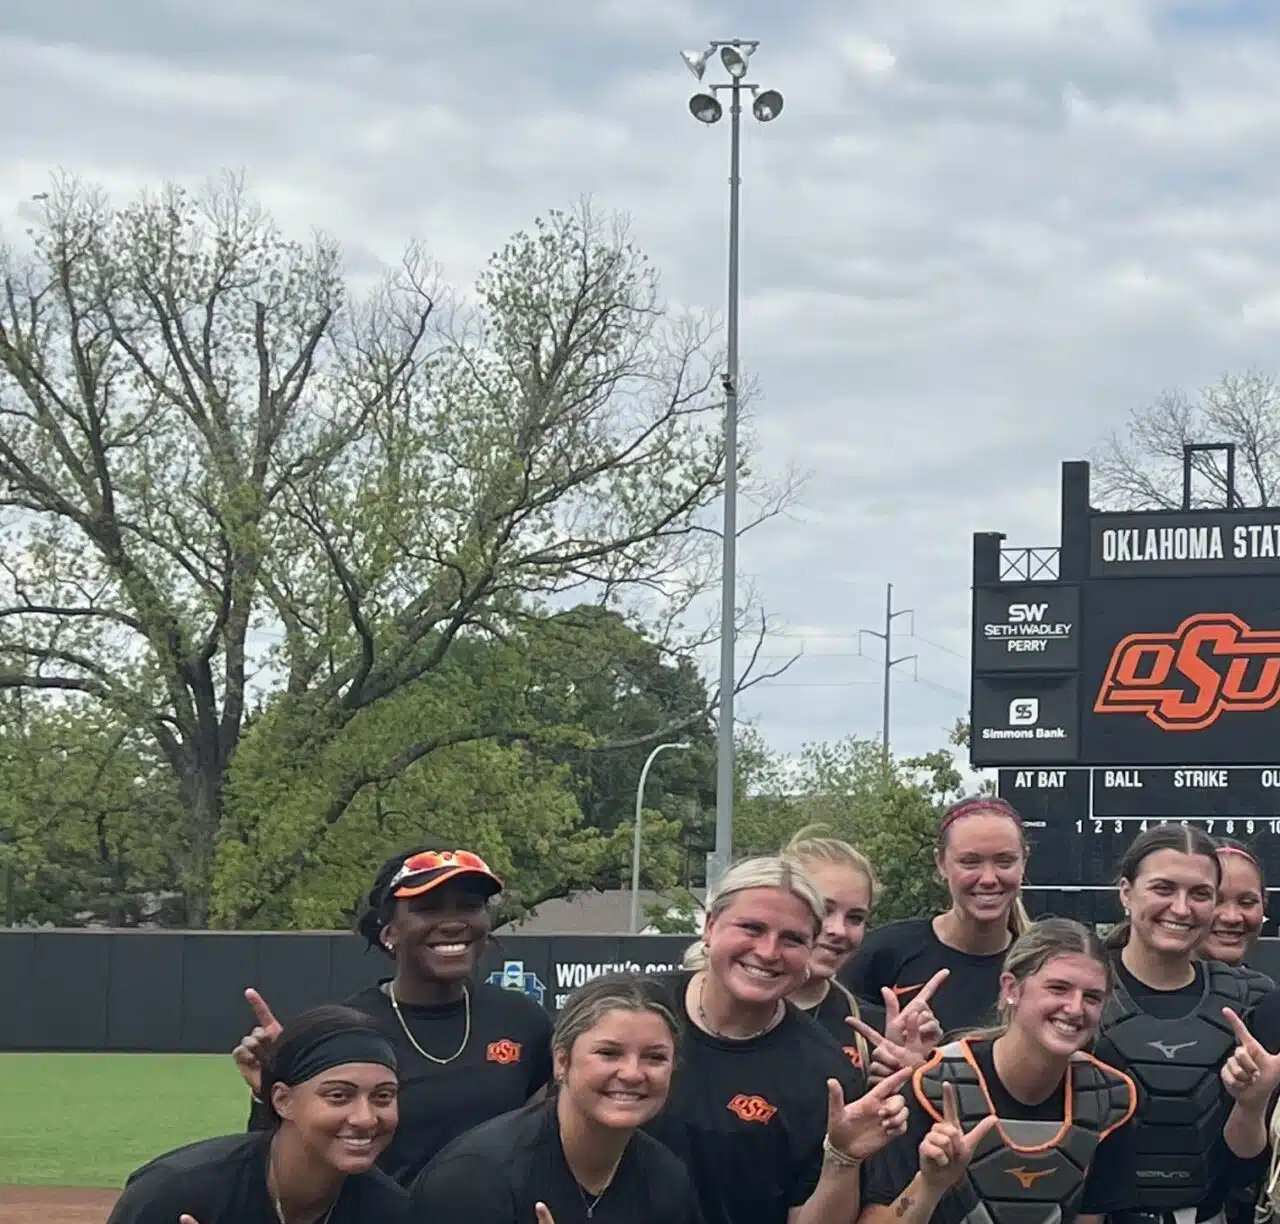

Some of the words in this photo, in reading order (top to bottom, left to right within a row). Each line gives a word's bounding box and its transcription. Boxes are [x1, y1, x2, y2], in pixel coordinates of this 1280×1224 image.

[1102, 526, 1224, 562] OKLAHOMA
[1008, 603, 1049, 622] SW
[984, 624, 1018, 636] SETH
[1019, 623, 1072, 635] WADLEY
[1007, 639, 1048, 652] PERRY
[982, 728, 1034, 739] Simmons
[1014, 770, 1034, 788] AT
[1037, 770, 1067, 788] BAT
[1104, 770, 1143, 788] BALL
[1173, 770, 1229, 788] STRIKE
[1075, 819, 1083, 834] 1
[1094, 819, 1103, 834] 2
[1114, 819, 1123, 834] 3
[1139, 819, 1148, 833] 4
[1205, 819, 1215, 834] 7
[1226, 819, 1234, 834] 8
[1246, 819, 1255, 834] 9
